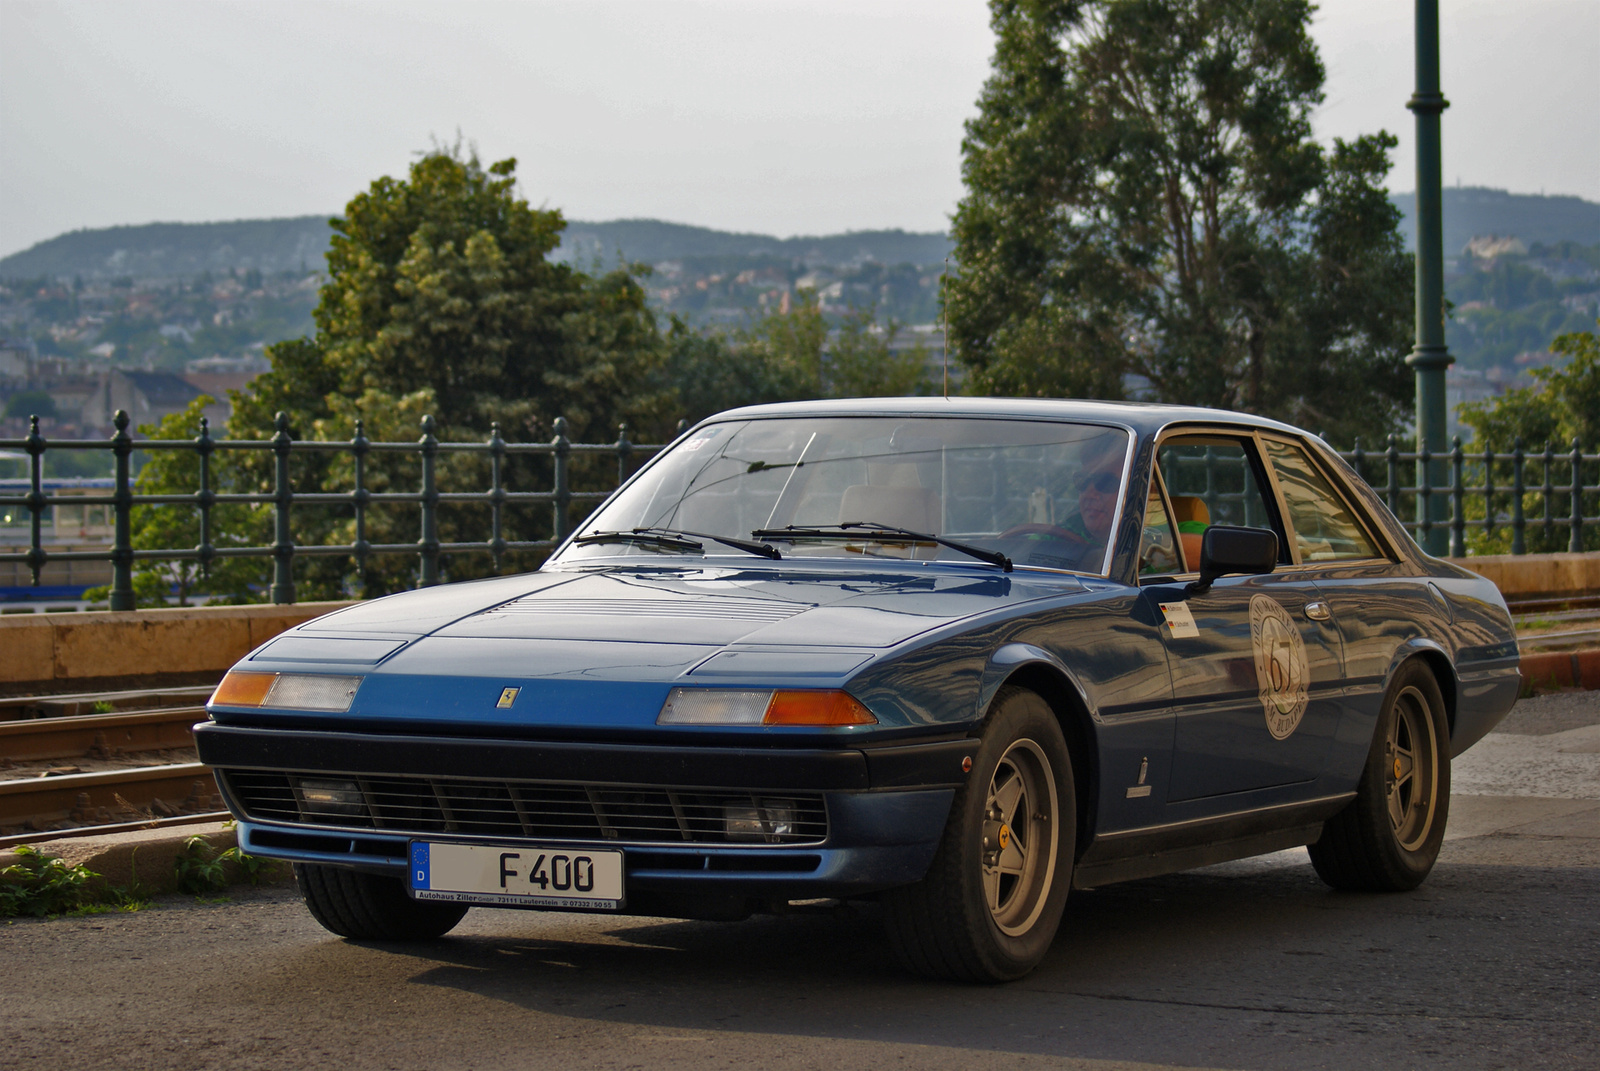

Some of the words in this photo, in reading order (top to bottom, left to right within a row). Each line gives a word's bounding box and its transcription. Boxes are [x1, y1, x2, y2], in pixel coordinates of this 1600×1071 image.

[1261, 600, 1300, 648] MASTERS
[1270, 639, 1291, 693] 67
[417, 870, 425, 881] D
[500, 852, 520, 887] F
[530, 854, 594, 891] 400
[419, 891, 455, 901] Autohaus
[456, 893, 477, 902] Ziller
[498, 896, 518, 904] 73111
[519, 898, 558, 906] Lauterstein
